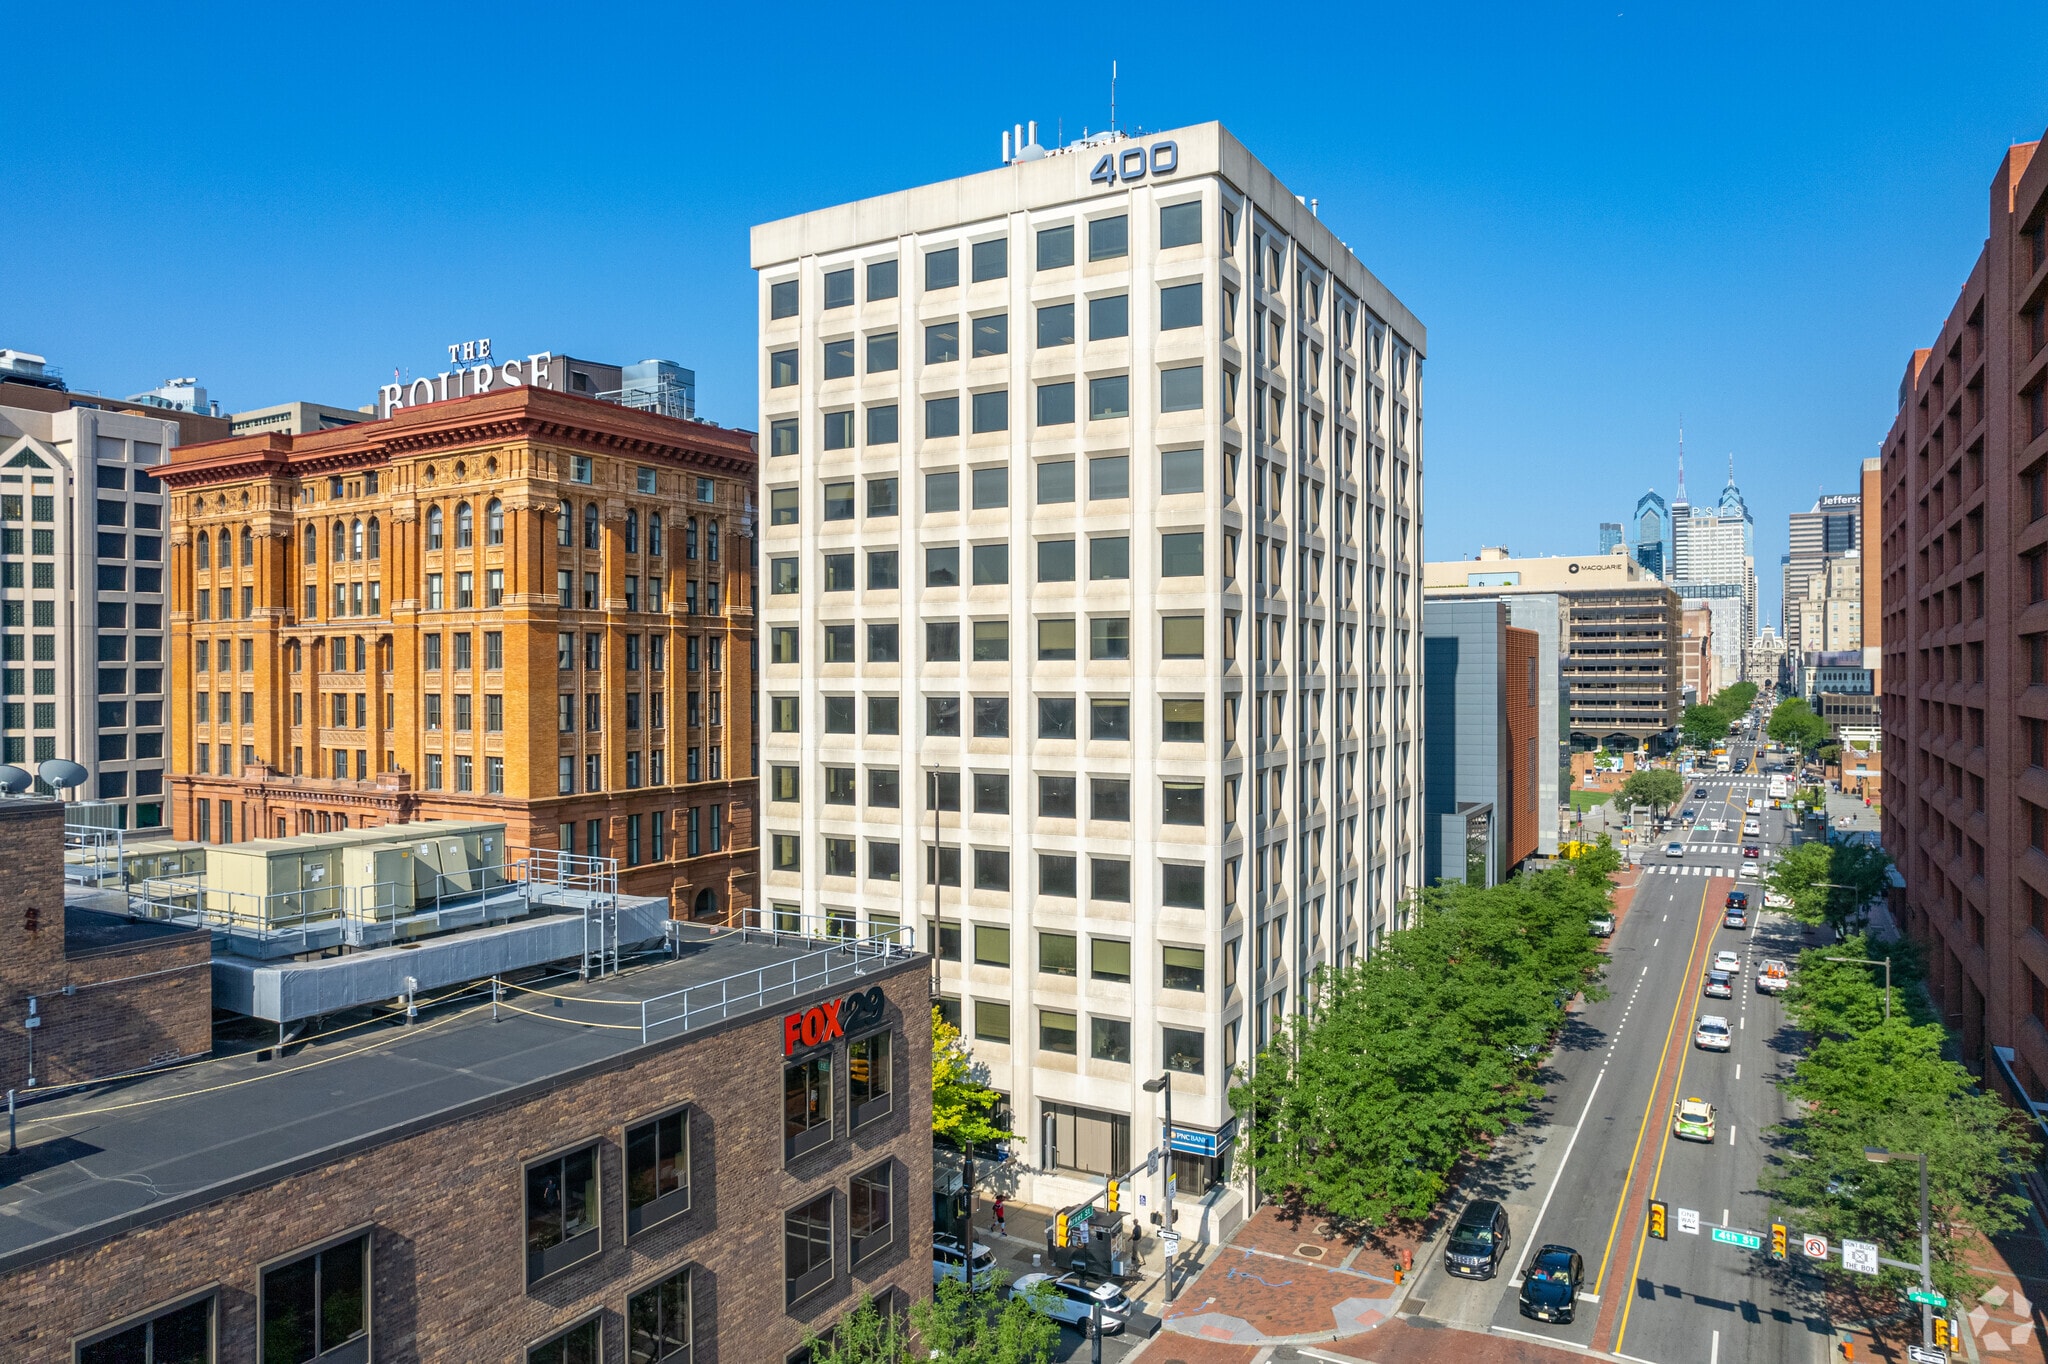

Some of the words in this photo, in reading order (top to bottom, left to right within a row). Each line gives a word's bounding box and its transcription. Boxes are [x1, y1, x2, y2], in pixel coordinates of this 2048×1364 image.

[1090, 140, 1178, 183] 400
[448, 338, 492, 363] THE
[381, 351, 553, 419] BOURSE
[1823, 495, 1861, 505] Jefferso
[1691, 505, 1743, 518] PSFS
[784, 998, 845, 1056] FOX
[843, 986, 885, 1035] 29
[1176, 1131, 1190, 1141] PNC
[1681, 1210, 1696, 1219] ONE
[1681, 1217, 1696, 1225] WAY
[1718, 1231, 1738, 1243] 4th
[1742, 1236, 1754, 1246] St
